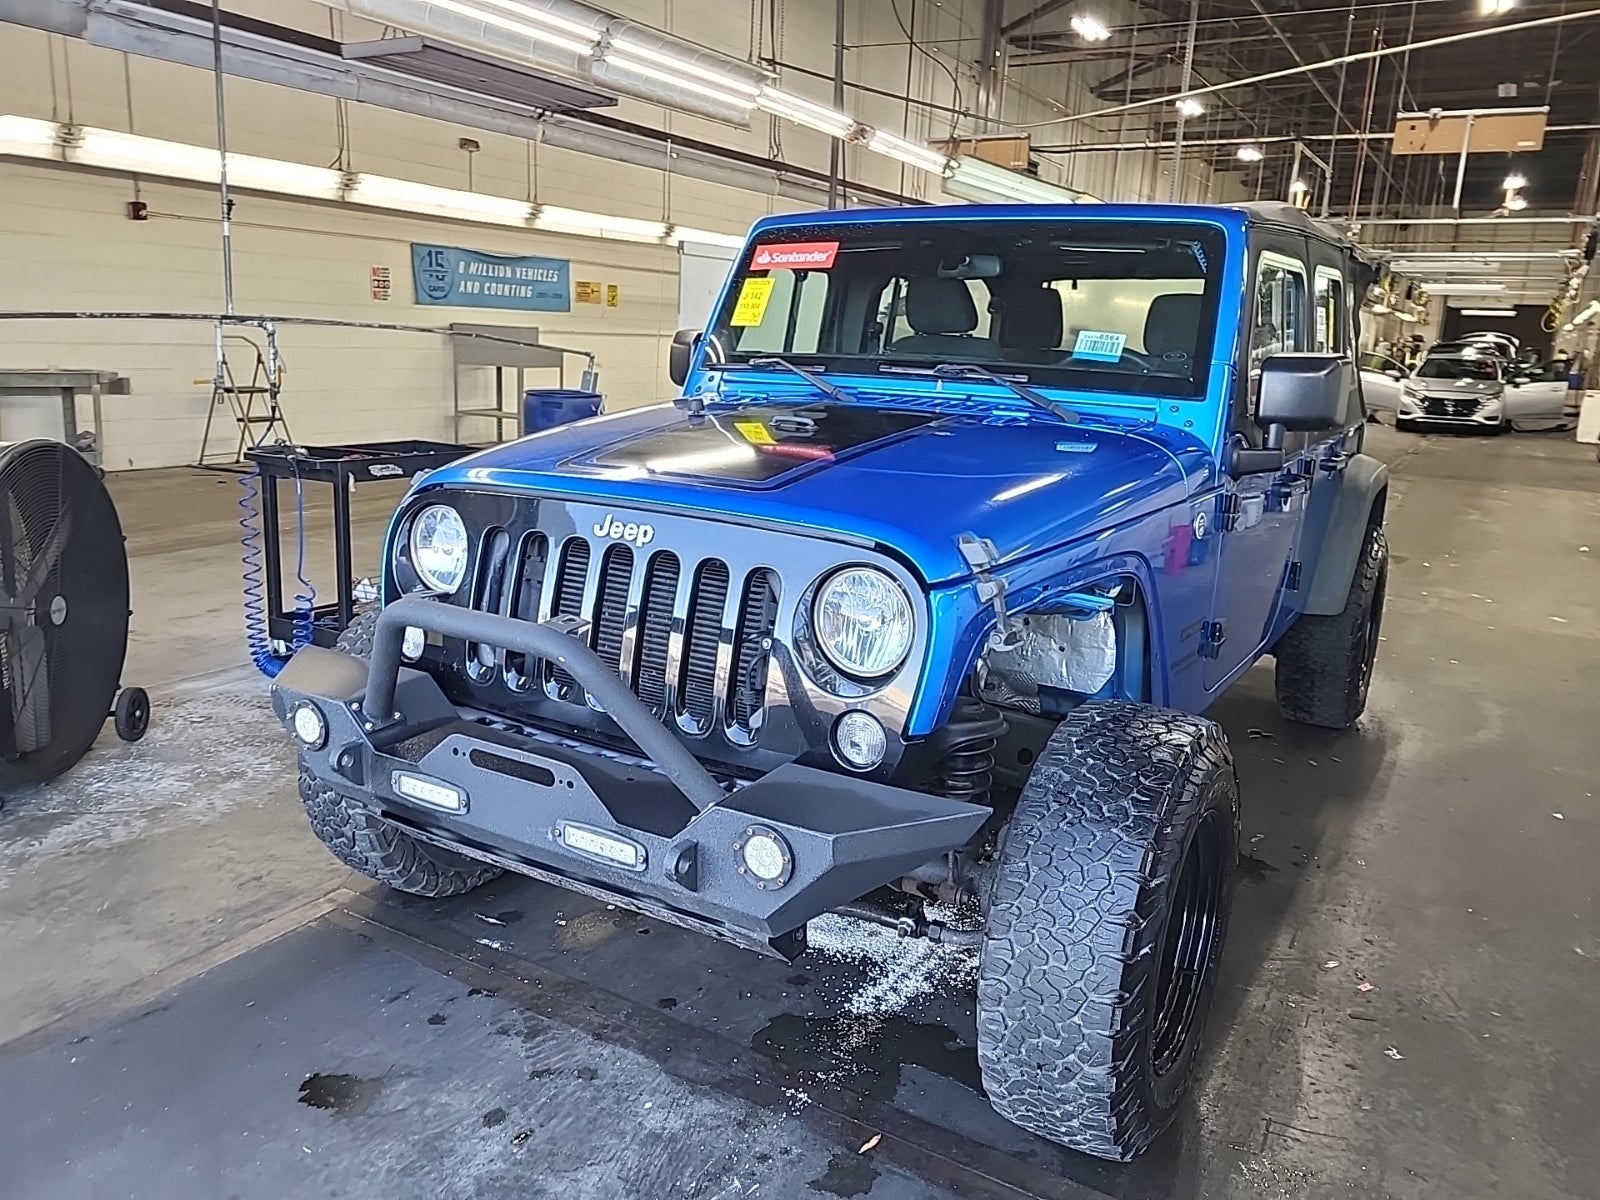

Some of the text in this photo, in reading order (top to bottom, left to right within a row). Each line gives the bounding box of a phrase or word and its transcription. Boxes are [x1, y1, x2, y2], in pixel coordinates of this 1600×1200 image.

[771, 251, 829, 264] Santander
[469, 262, 512, 278] MILLION
[514, 267, 559, 282] VEHICLES
[459, 280, 480, 294] AND
[484, 282, 533, 298] COUNTING
[593, 513, 655, 548] Jeep
